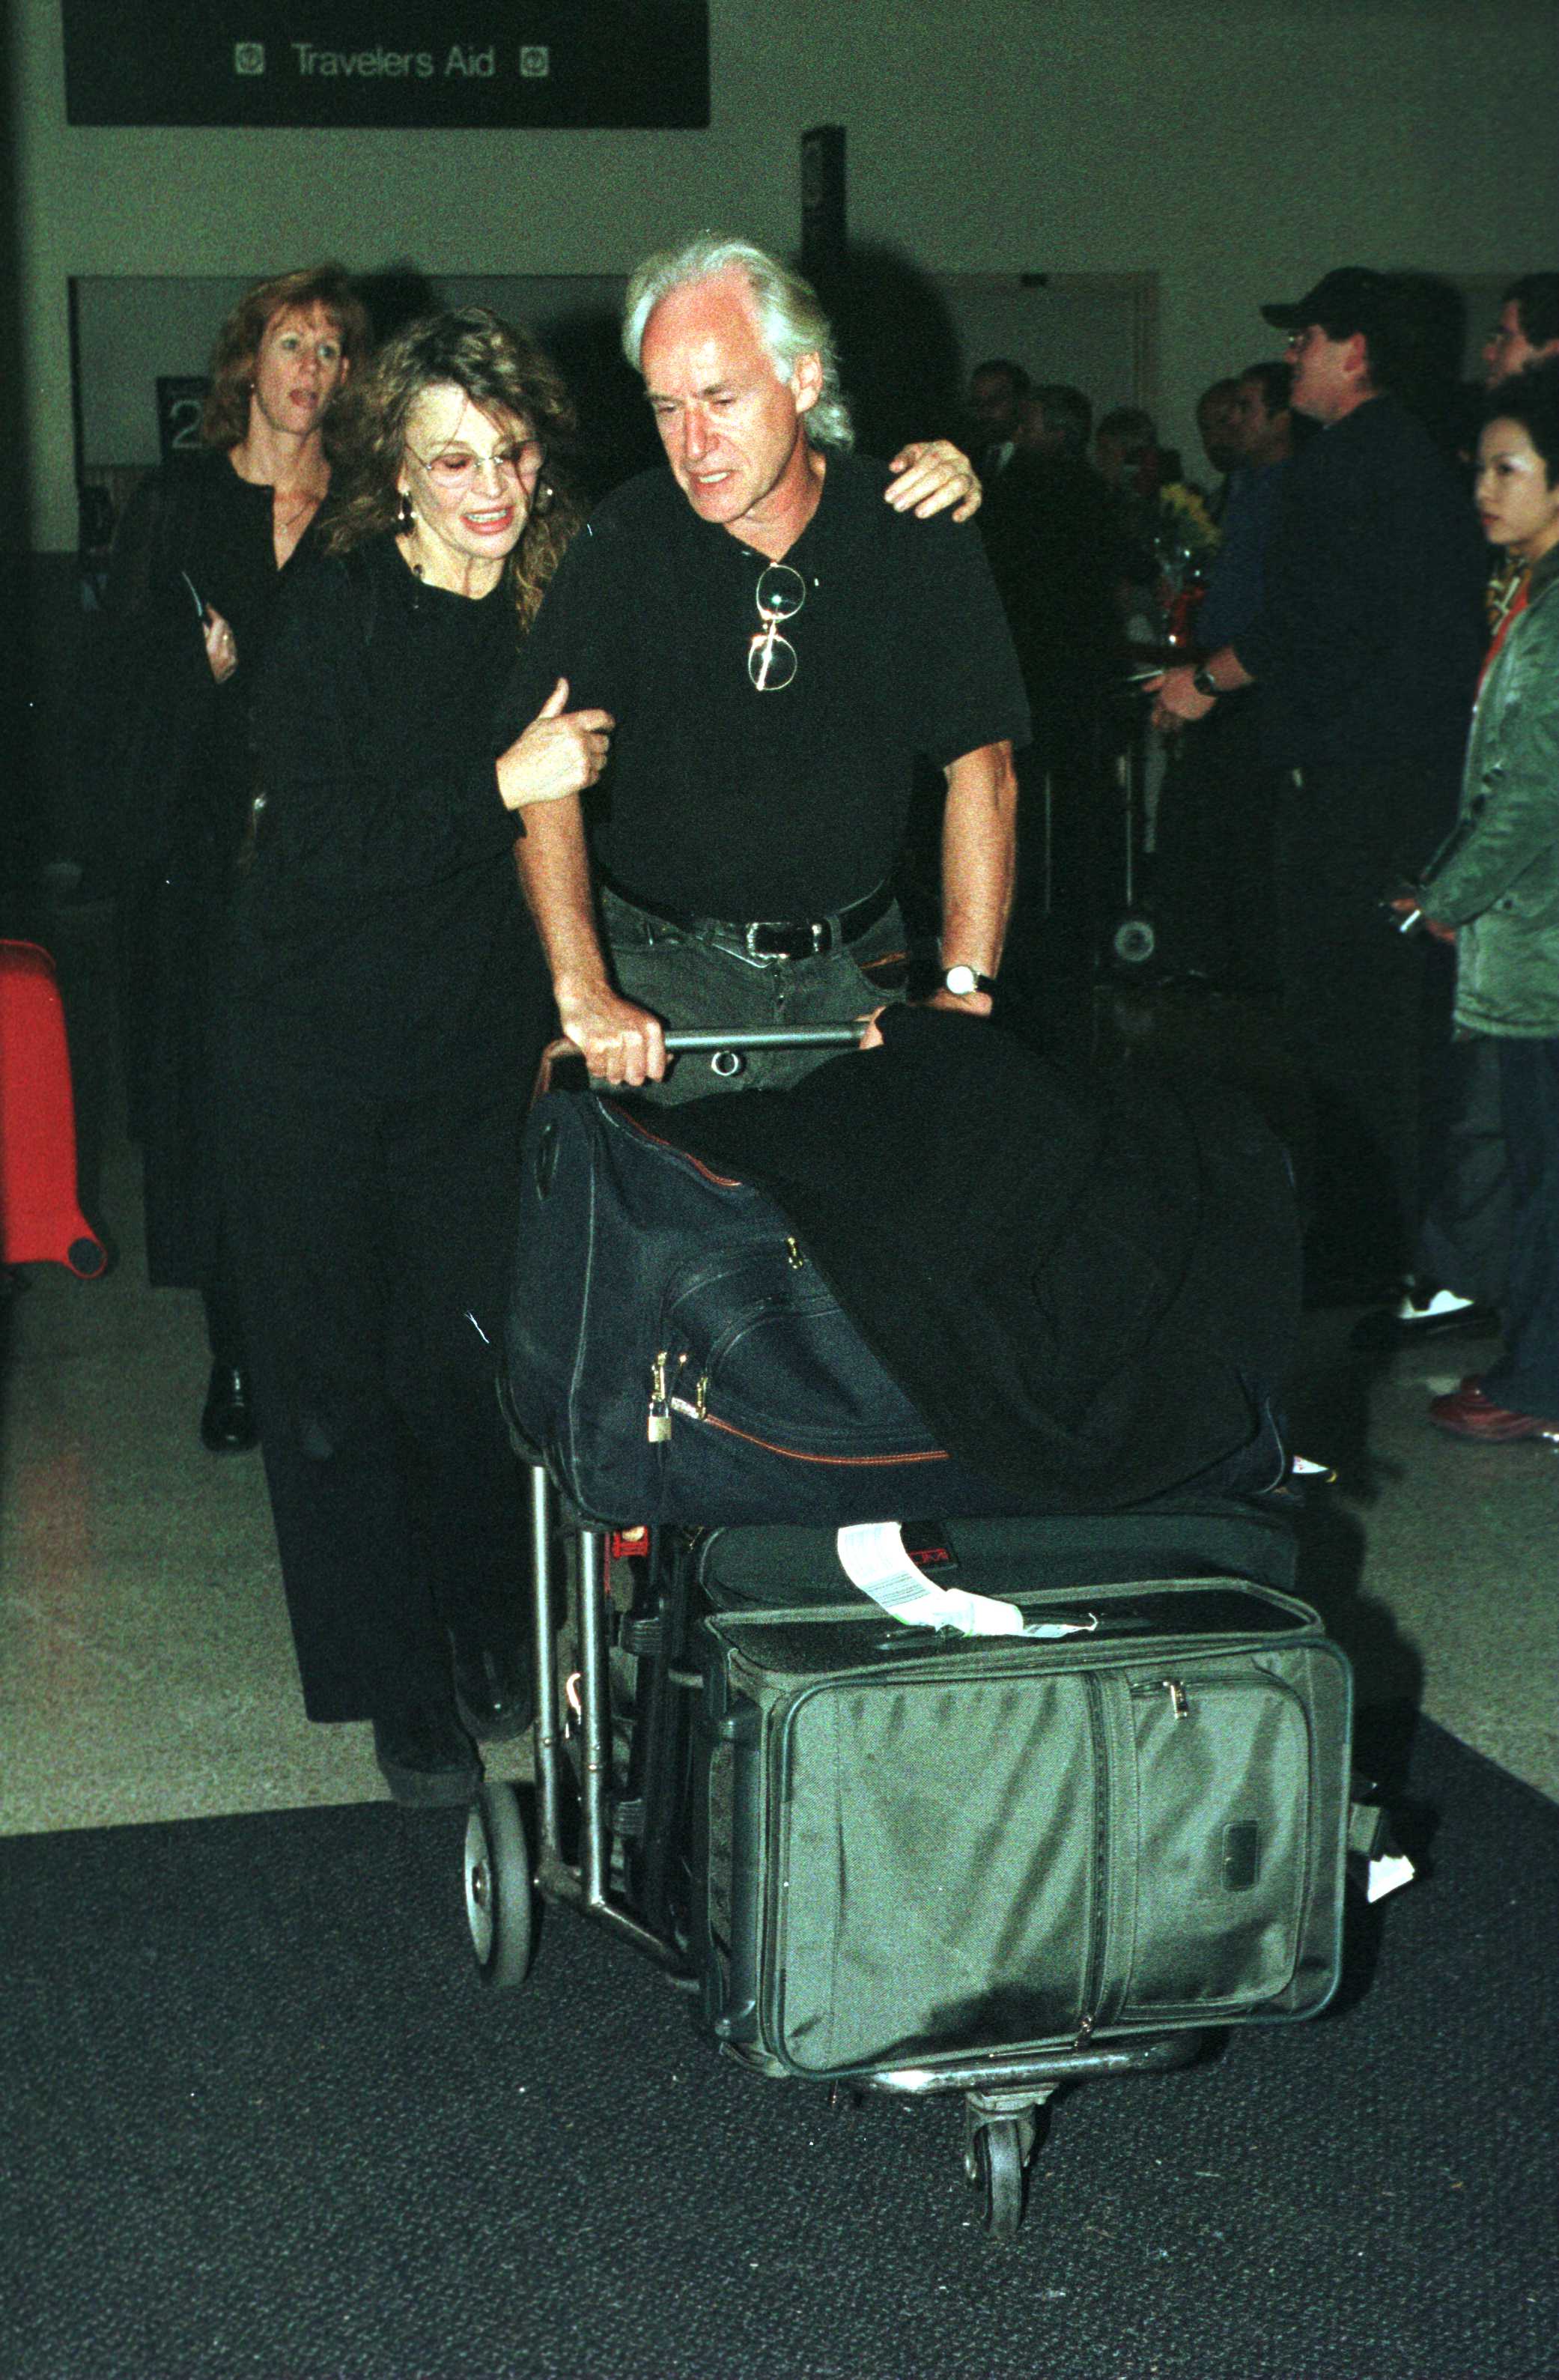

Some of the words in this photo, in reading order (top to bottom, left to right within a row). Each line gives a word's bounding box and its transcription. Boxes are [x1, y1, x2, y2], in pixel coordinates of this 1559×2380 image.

[292, 42, 435, 76] Travelers
[446, 44, 496, 76] Aid
[169, 399, 204, 449] 2
